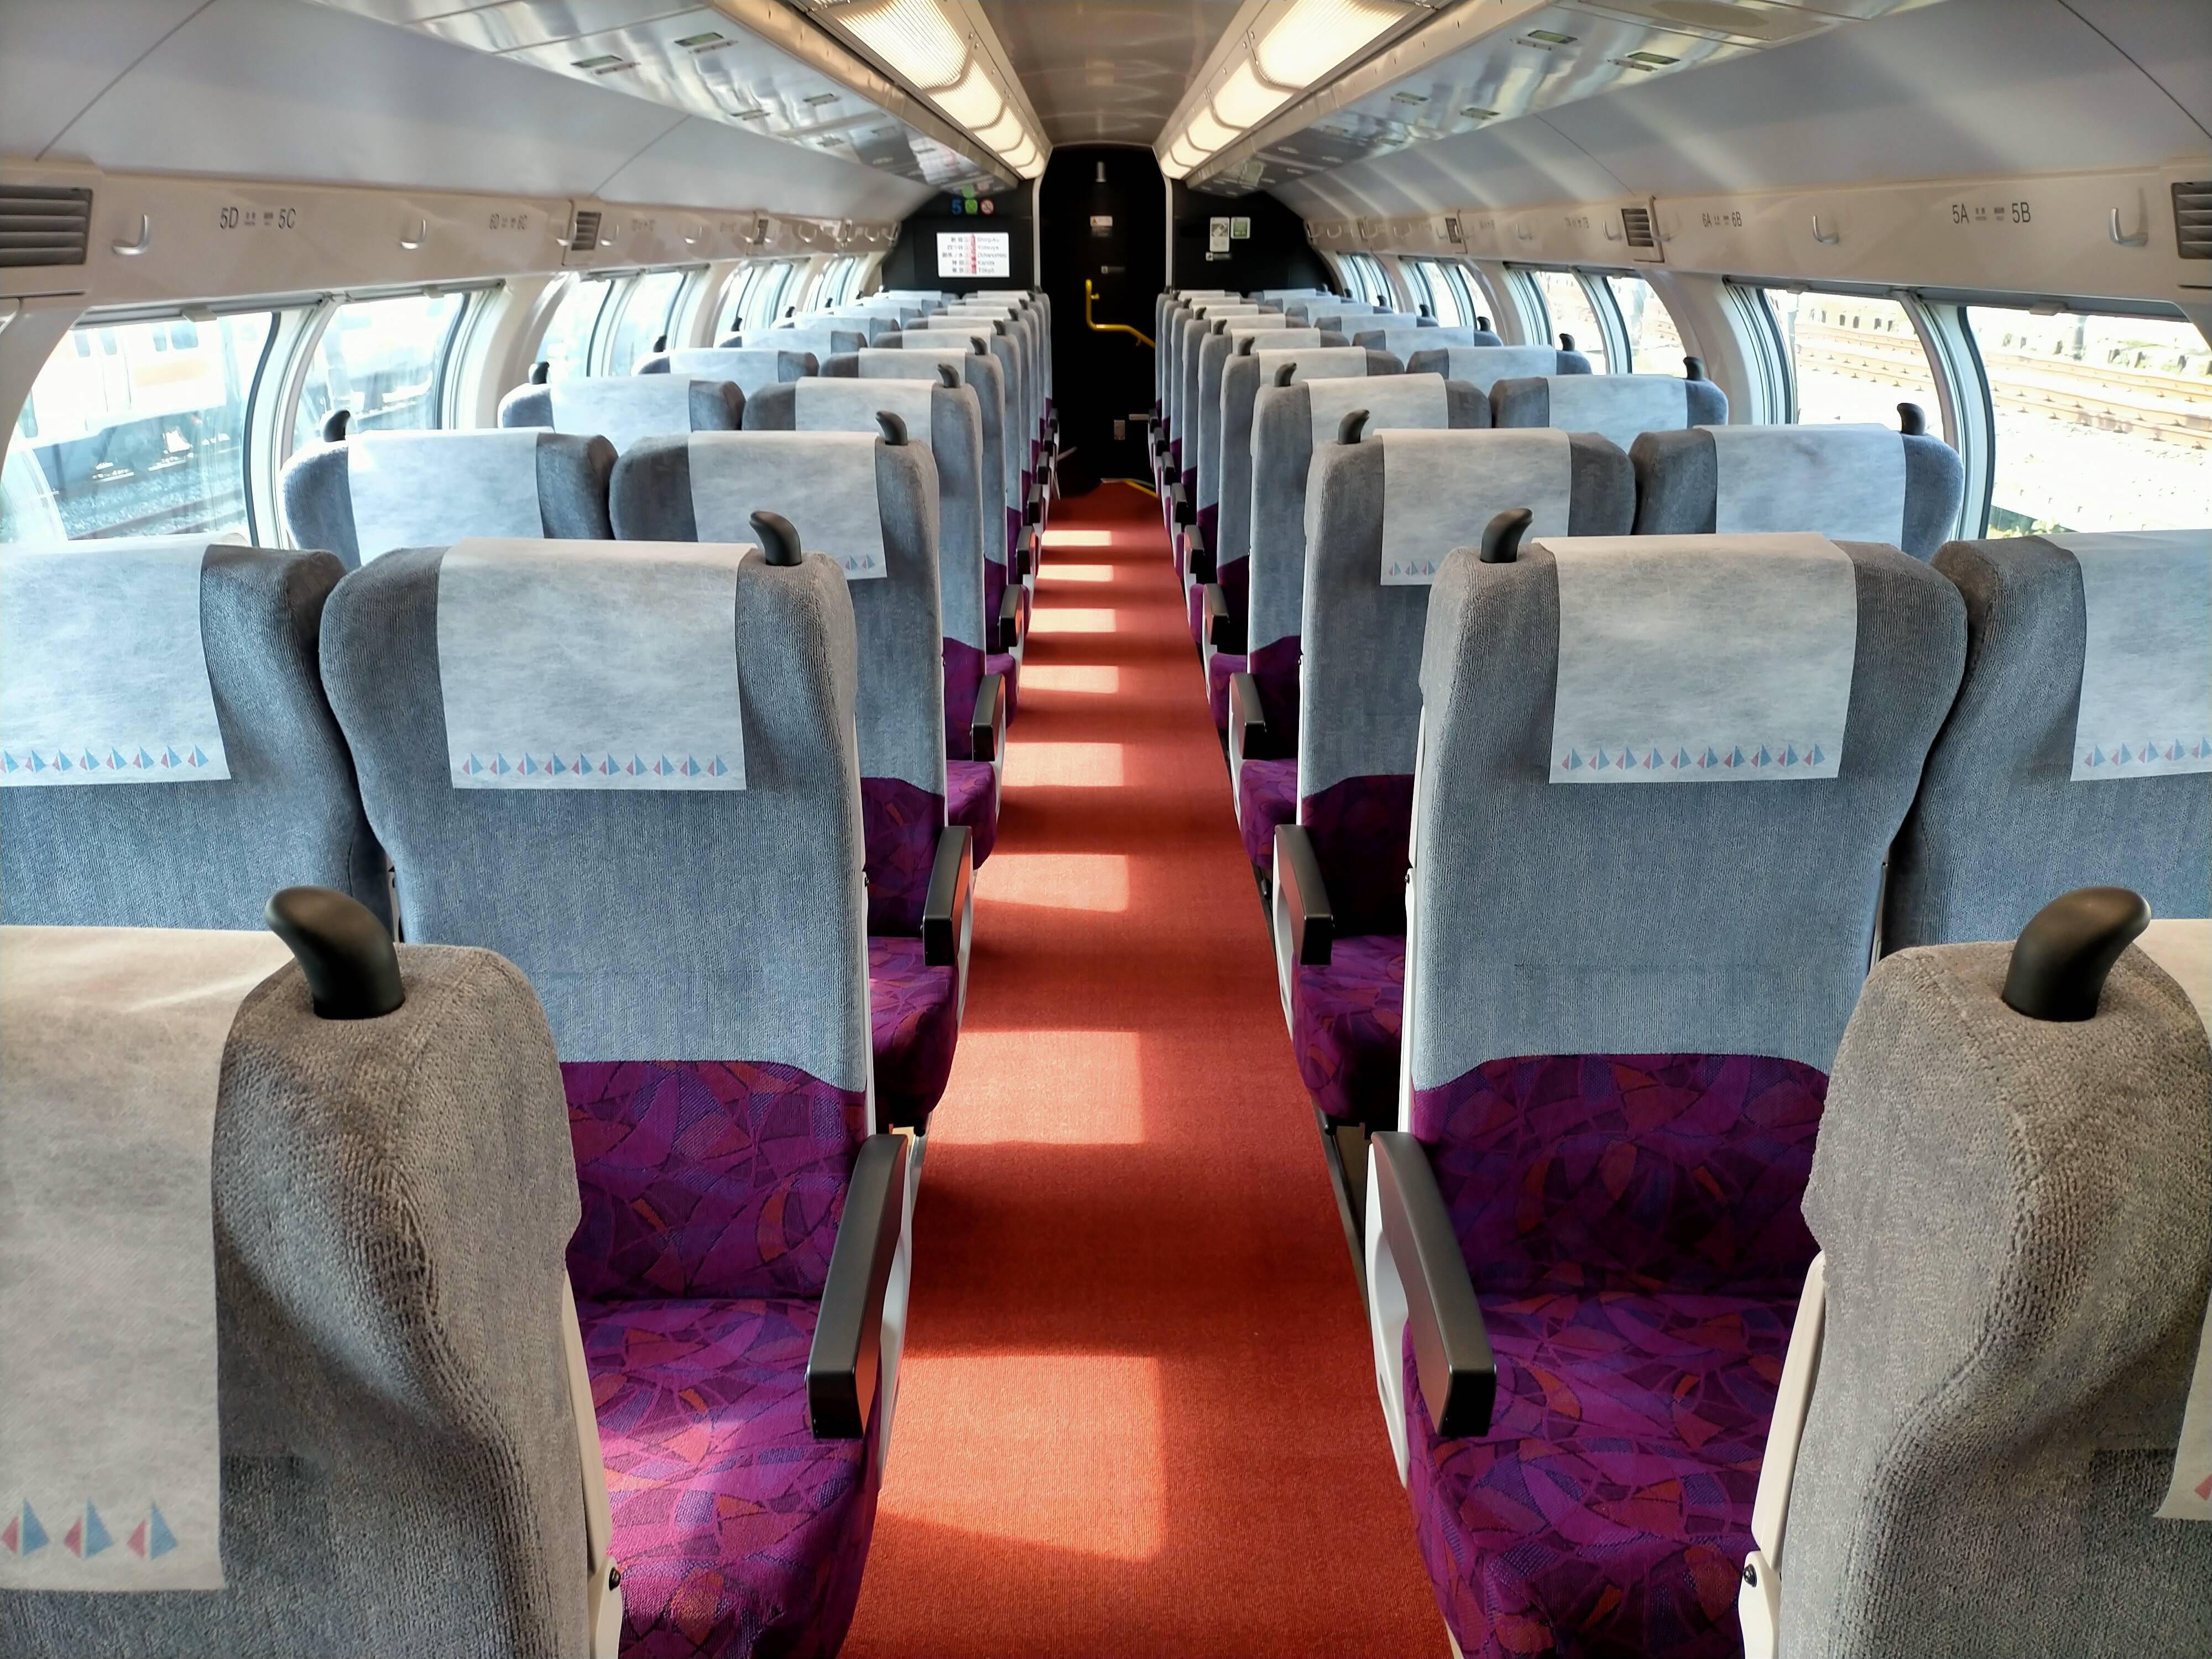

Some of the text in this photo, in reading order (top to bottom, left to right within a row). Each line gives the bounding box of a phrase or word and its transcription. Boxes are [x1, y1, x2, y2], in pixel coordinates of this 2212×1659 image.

[952, 199, 962, 215] 5
[1952, 203, 1969, 224] 5A
[2012, 202, 2031, 223] 5B
[220, 206, 239, 229] 5D
[278, 207, 296, 229] 5C
[1702, 212, 1713, 228] 6A
[1732, 211, 1742, 227] 6B
